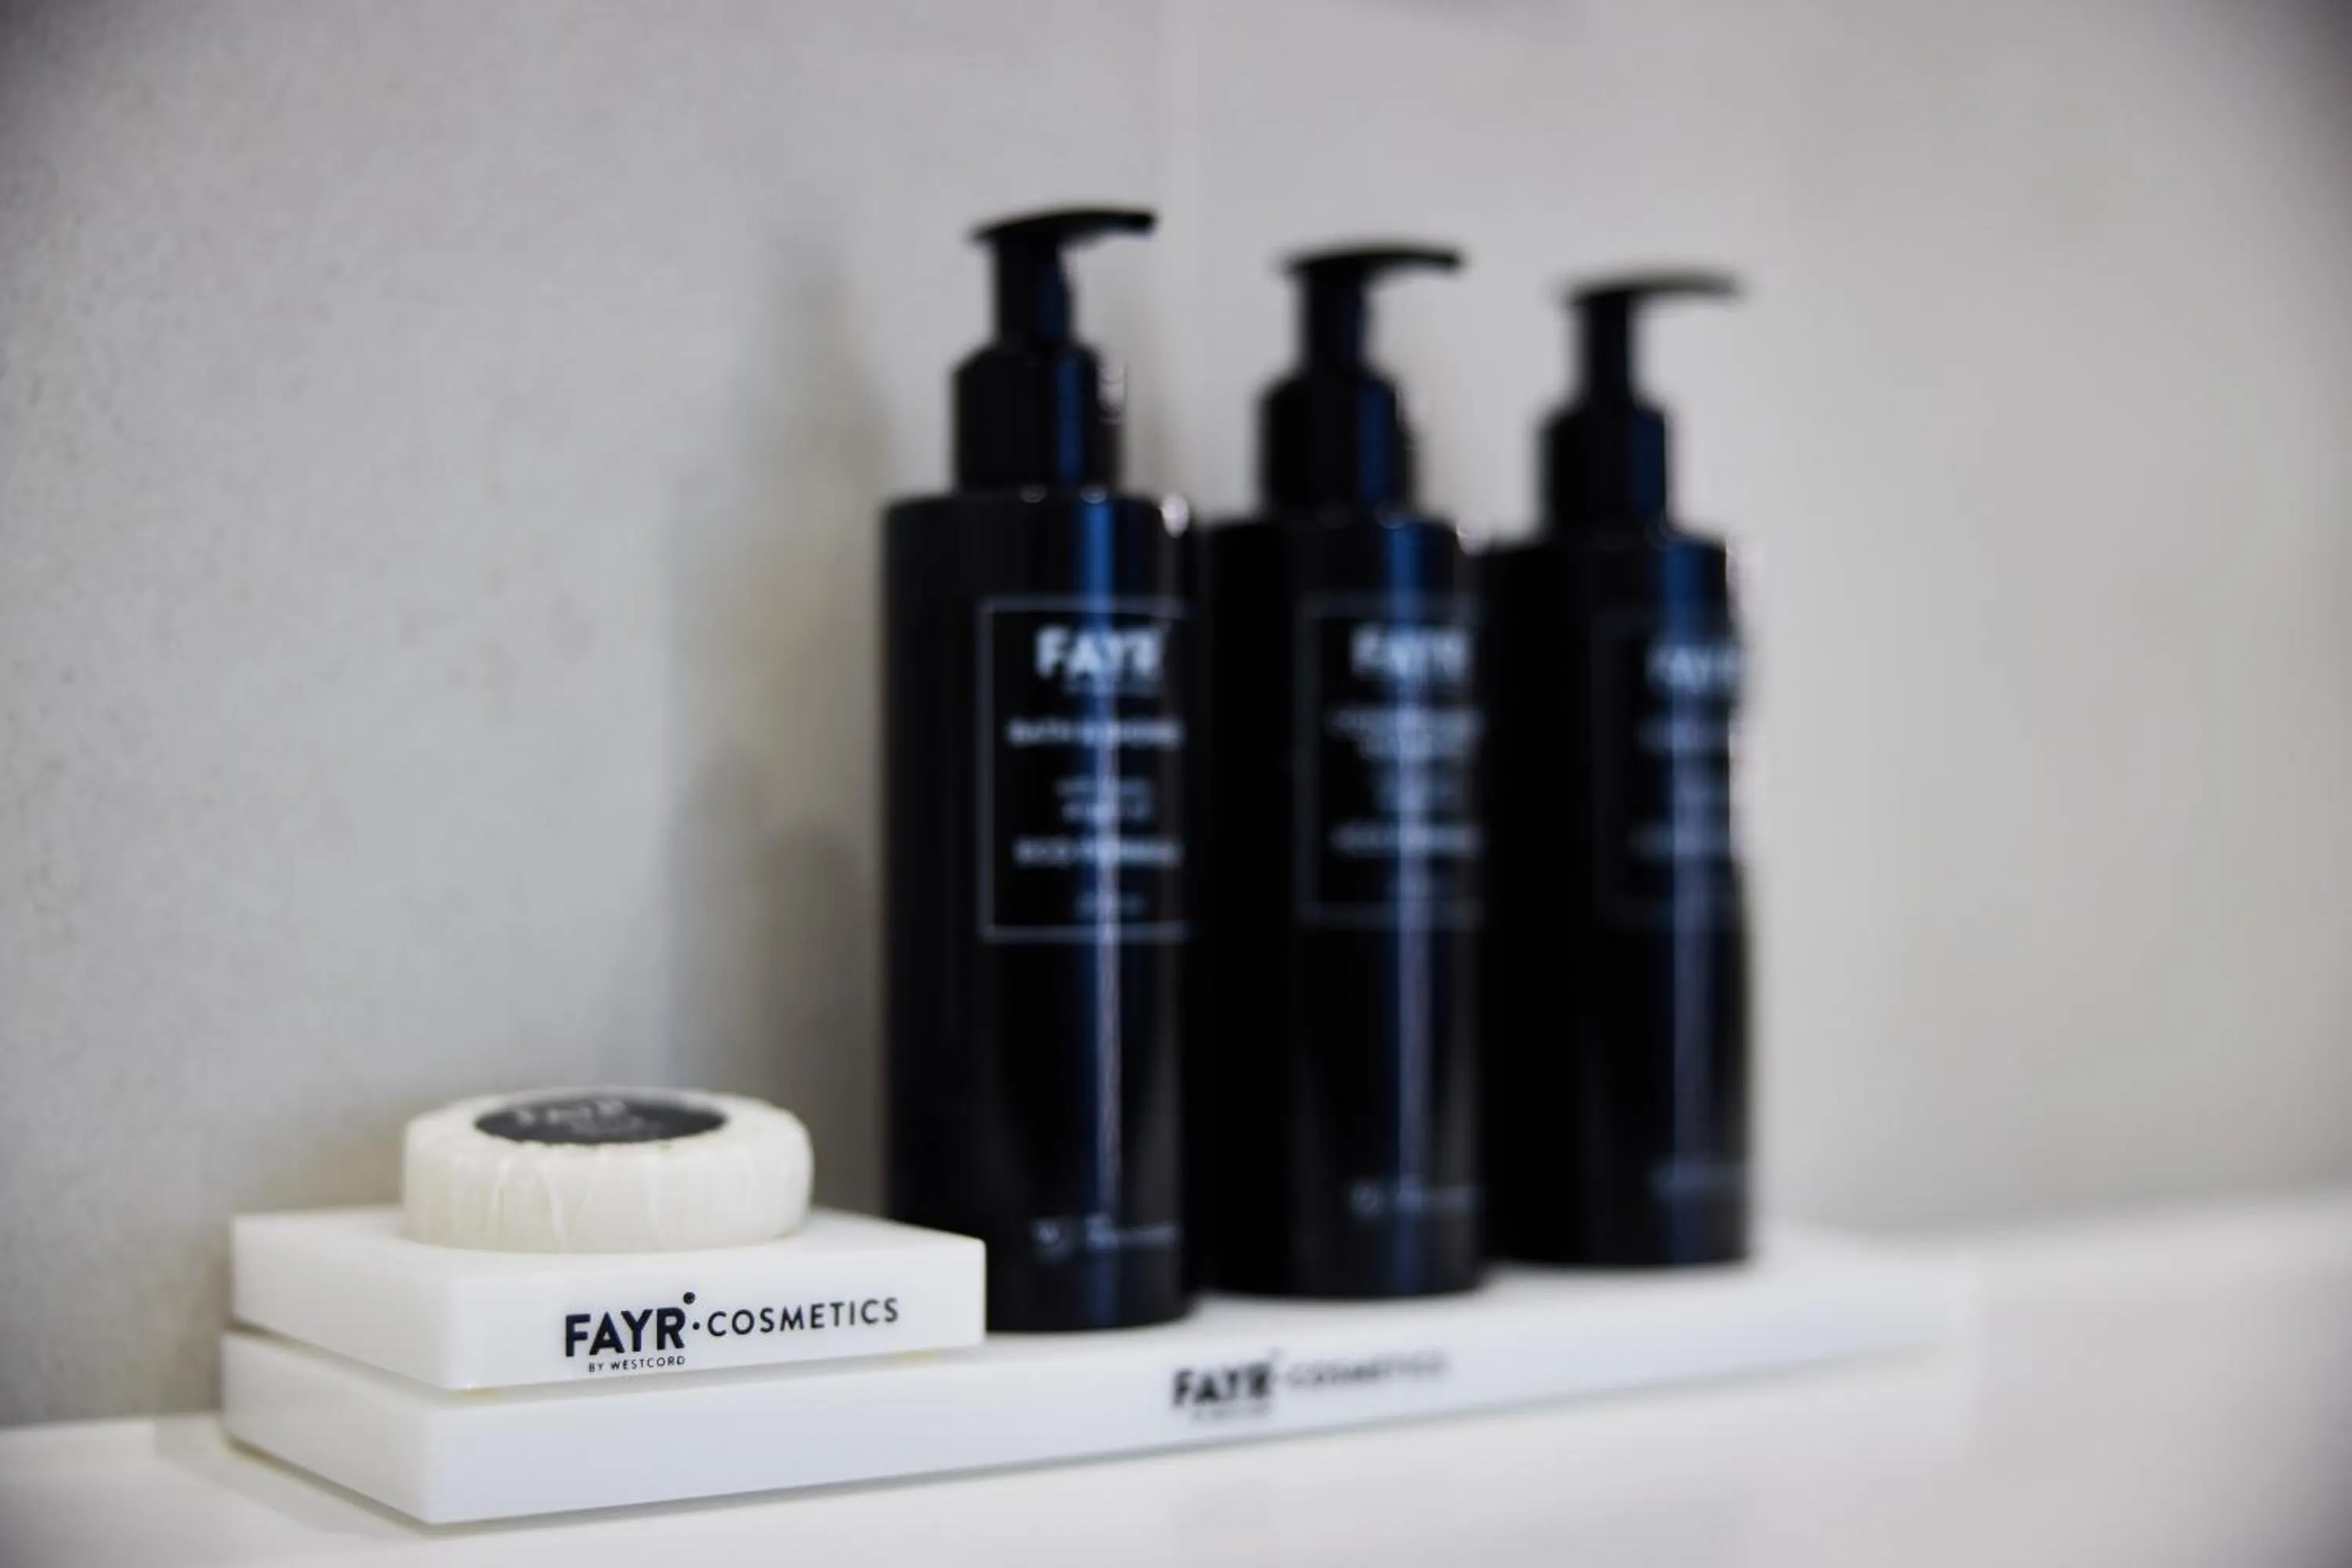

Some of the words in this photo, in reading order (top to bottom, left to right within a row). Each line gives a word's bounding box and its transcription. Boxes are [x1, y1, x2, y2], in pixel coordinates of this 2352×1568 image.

[564, 1307, 687, 1357] FAYR
[707, 1298, 899, 1337] COSMETICS
[588, 1362, 604, 1373] BY
[610, 1355, 686, 1371] WESTCORD
[1173, 1360, 1273, 1407] FAYR
